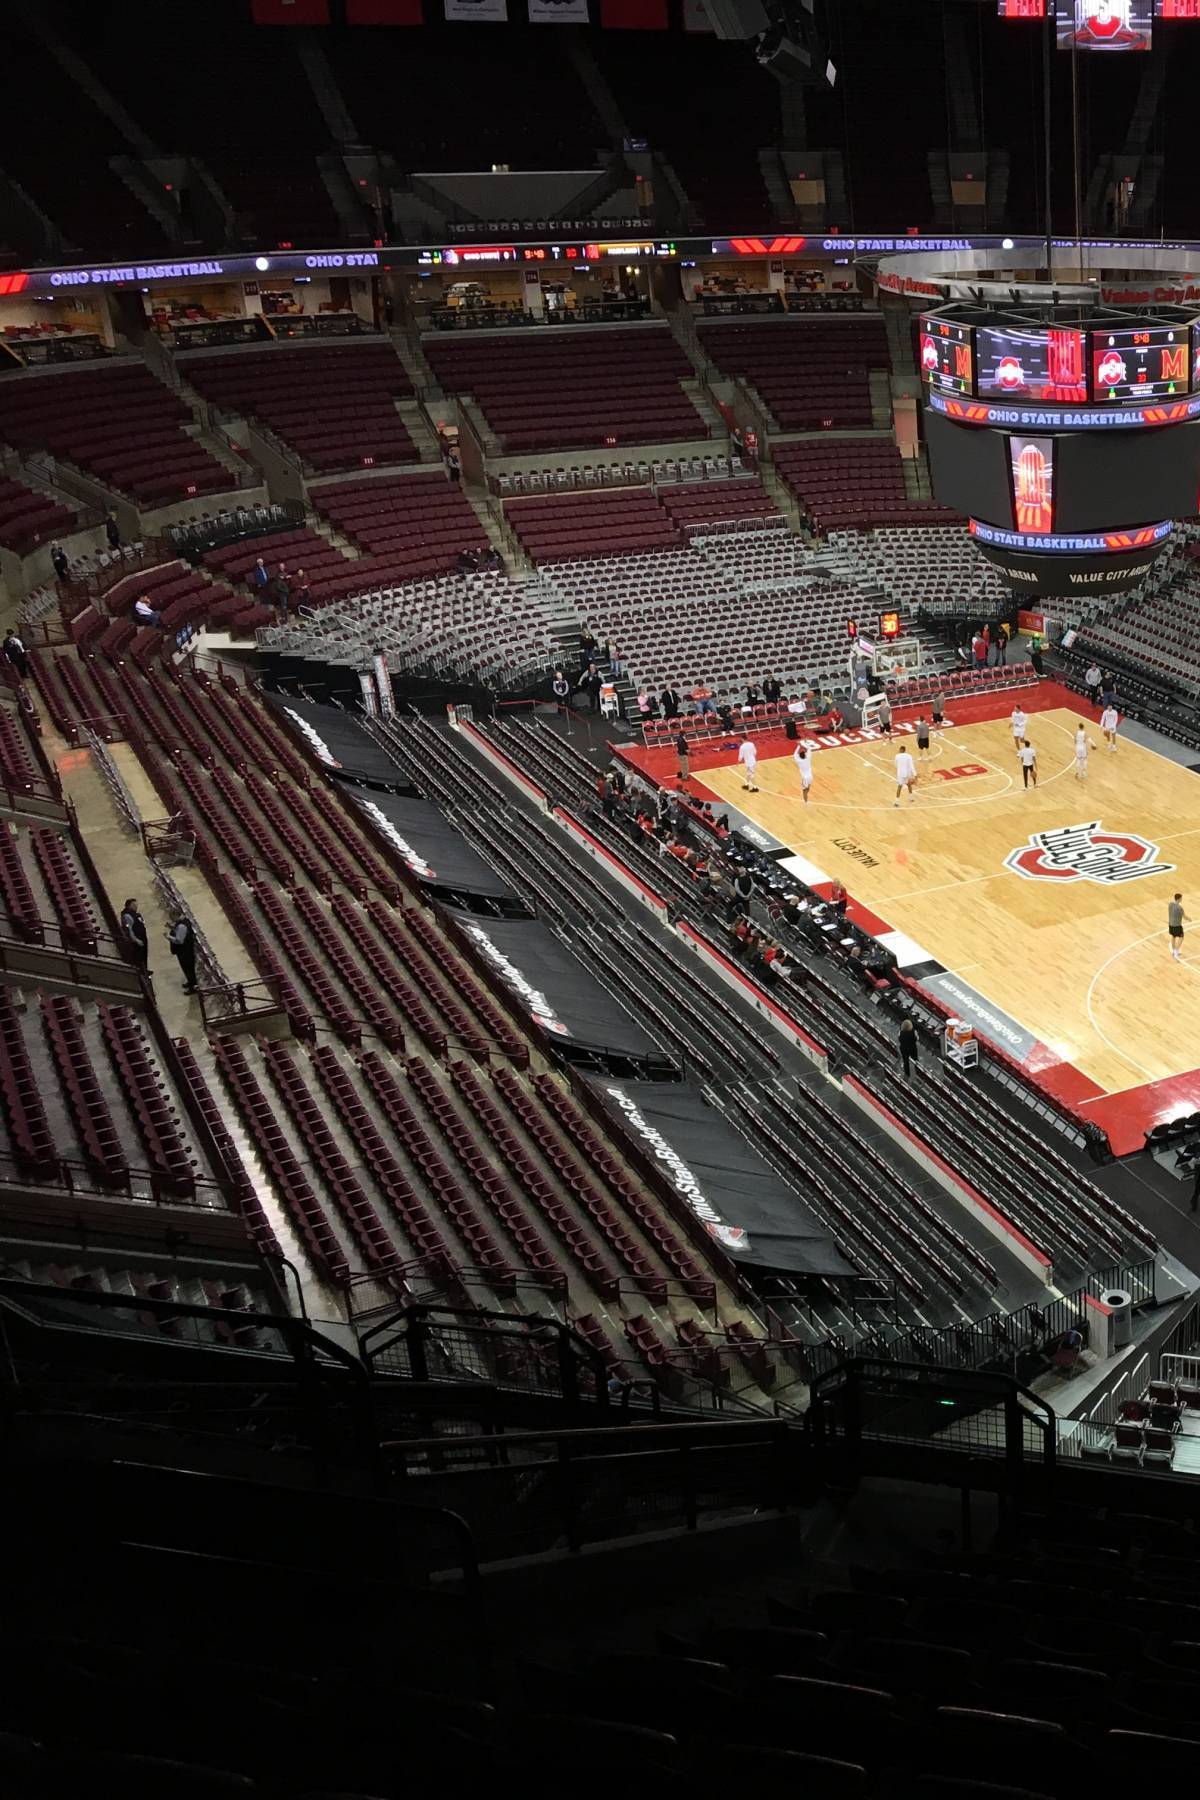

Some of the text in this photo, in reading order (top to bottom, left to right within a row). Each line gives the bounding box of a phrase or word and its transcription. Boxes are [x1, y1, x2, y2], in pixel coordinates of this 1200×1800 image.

[823, 239, 971, 250] OHIO STATE BASKETBALL
[305, 254, 343, 268] OHIO
[51, 262, 223, 287] OHIO STATE BASKETBALL
[1101, 287, 1150, 304] Value
[1154, 286, 1184, 303] City
[1108, 331, 1174, 346] 0 9:48 0
[1160, 349, 1185, 379] M
[988, 410, 1145, 425] OHIO STATE BASKETBALL
[976, 526, 1107, 549] OHIO STATE BASKETBALL
[1008, 568, 1039, 582] ARENA
[1069, 572, 1103, 583] VALUE
[1106, 569, 1130, 580] CITY
[881, 621, 897, 633] 30
[847, 850, 880, 869] VALUE
